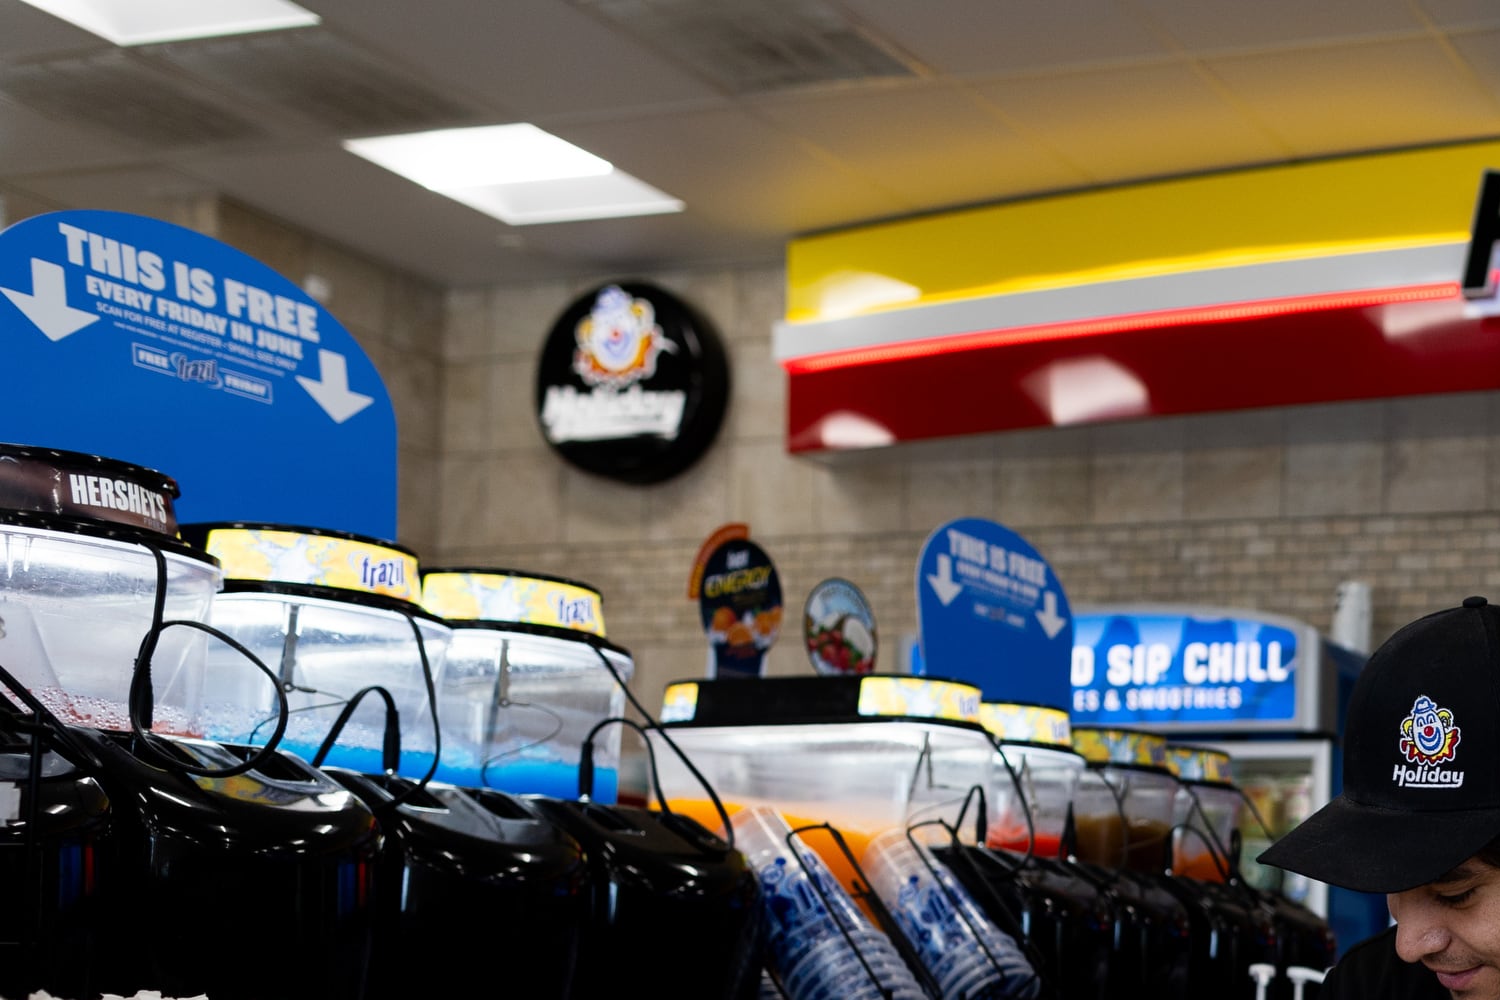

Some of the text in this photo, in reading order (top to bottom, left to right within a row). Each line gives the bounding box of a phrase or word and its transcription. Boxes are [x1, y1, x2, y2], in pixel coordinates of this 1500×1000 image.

[58, 222, 319, 343] THIS IS FREE
[86, 275, 152, 312] EVERY
[157, 297, 227, 336] FRIDAY
[231, 320, 253, 345] IN
[256, 329, 304, 360] JUNE
[96, 301, 123, 318] SCAN
[124, 308, 142, 324] FOR
[138, 349, 169, 370] FREE
[177, 357, 218, 383] frazil
[69, 473, 167, 524] HERSHEY'S
[362, 558, 404, 588] frazil
[558, 597, 594, 624] frazil
[1107, 643, 1172, 686] SIP
[1183, 641, 1289, 684] CHILL
[1126, 686, 1242, 711] SMOOTHIES
[1392, 764, 1465, 788] Holiday
